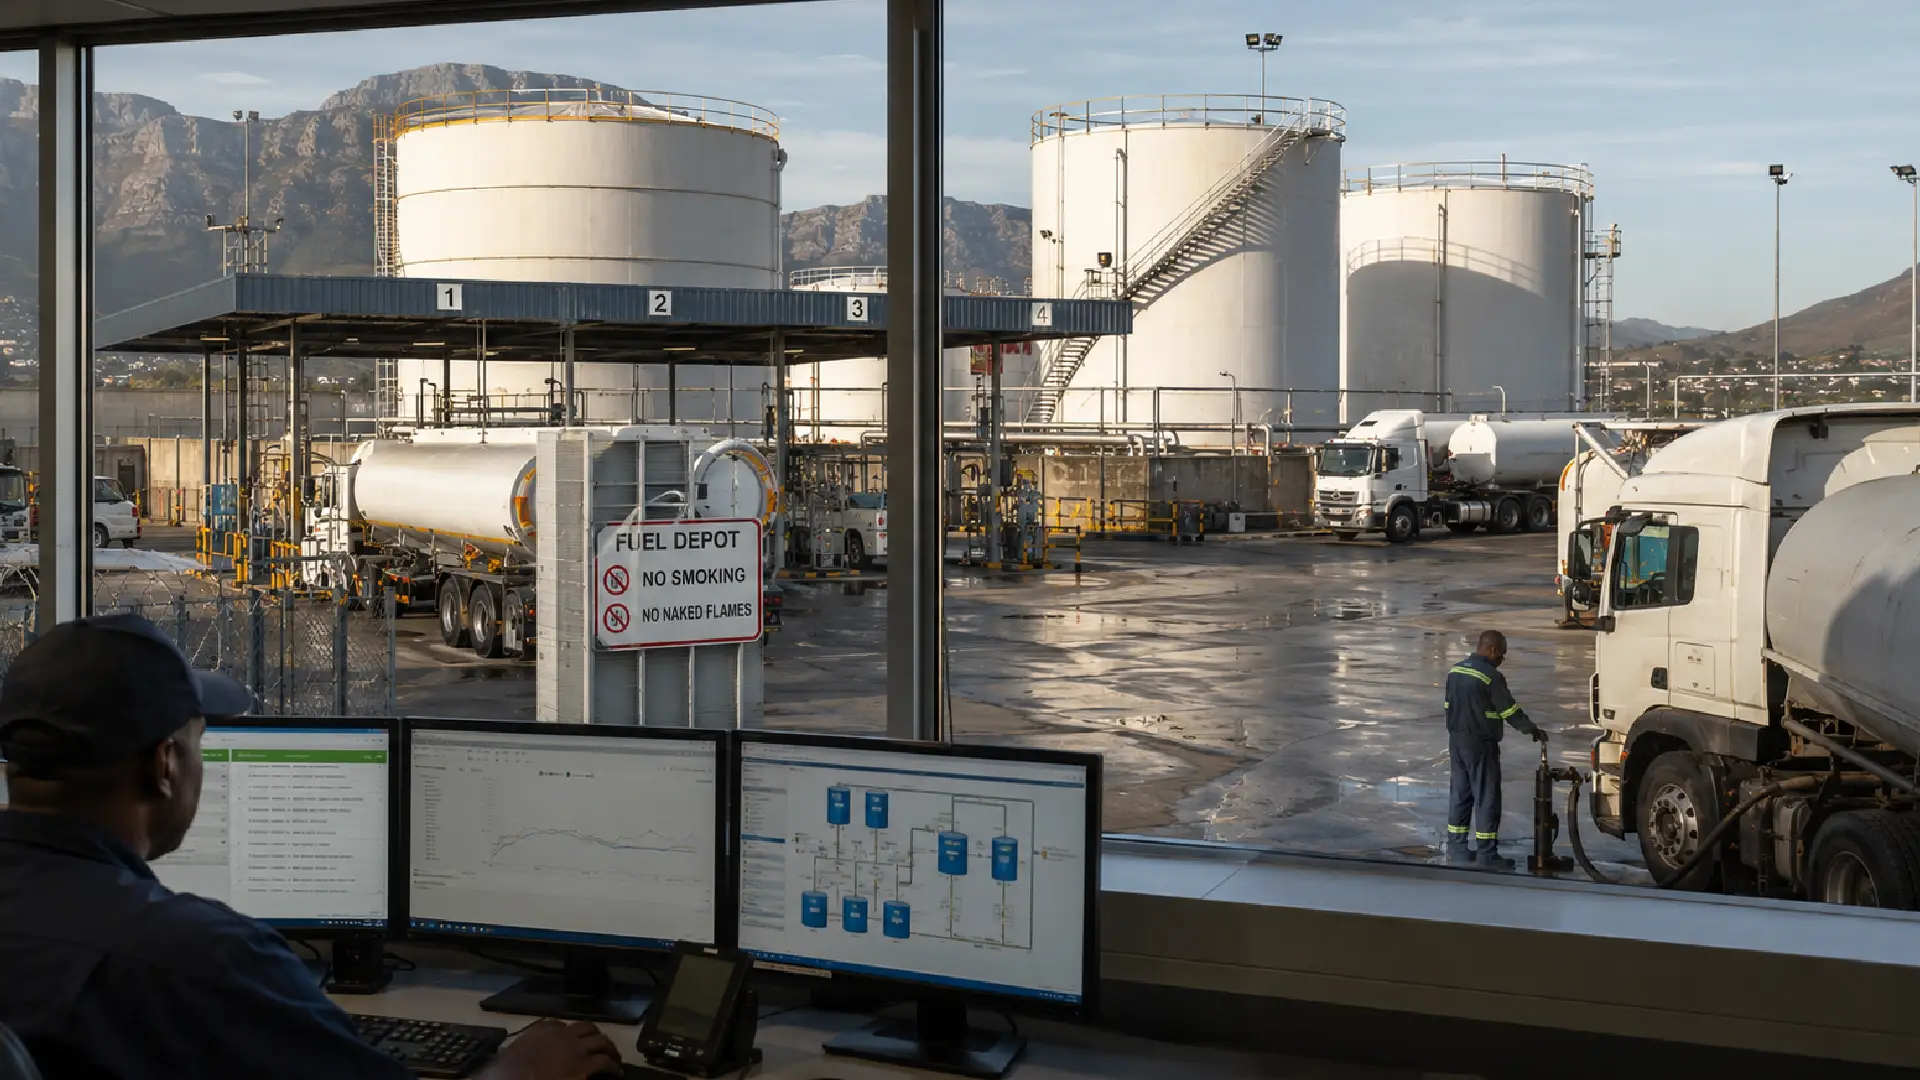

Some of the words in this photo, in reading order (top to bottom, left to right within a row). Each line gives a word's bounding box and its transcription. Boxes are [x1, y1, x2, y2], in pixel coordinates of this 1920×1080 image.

[444, 287, 454, 308] 1
[654, 293, 667, 313] 2
[851, 298, 864, 319] 3
[1036, 305, 1049, 323] 4
[615, 532, 667, 552] FUEL
[674, 530, 740, 549] DEPOT
[642, 570, 666, 587] NO
[671, 567, 745, 586] SMOKING
[642, 606, 660, 623] NO
[663, 604, 703, 622] NAKED
[706, 602, 753, 620] FLAMES
